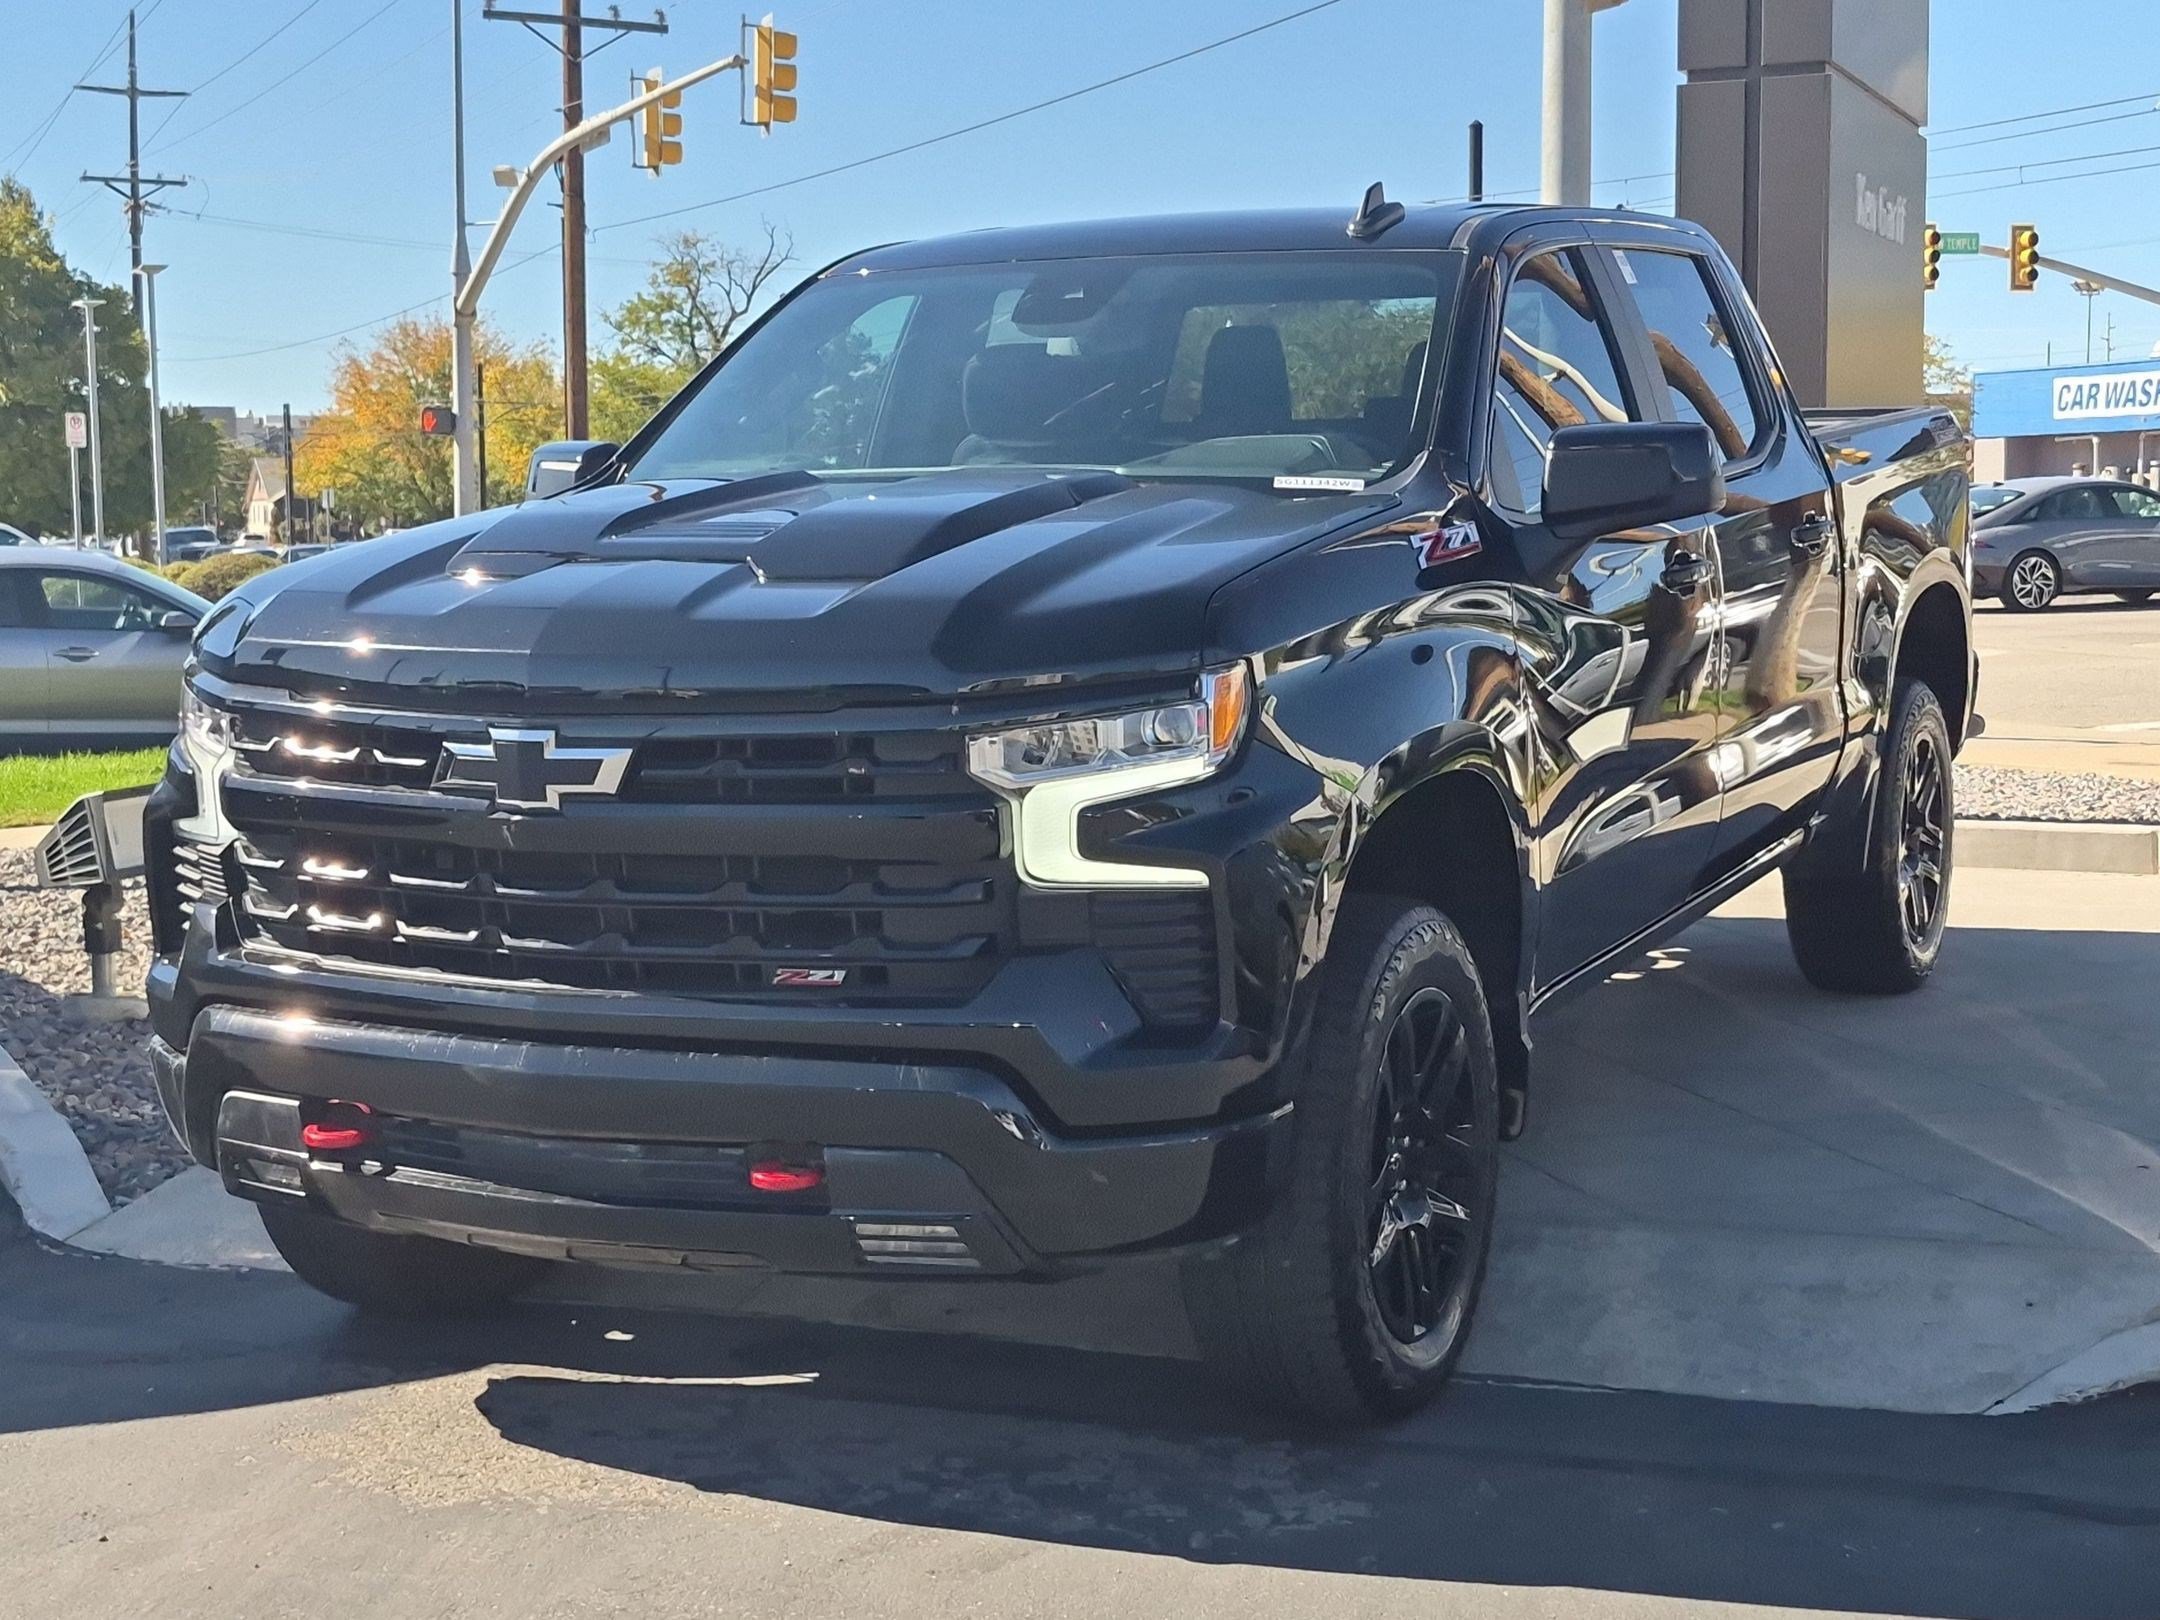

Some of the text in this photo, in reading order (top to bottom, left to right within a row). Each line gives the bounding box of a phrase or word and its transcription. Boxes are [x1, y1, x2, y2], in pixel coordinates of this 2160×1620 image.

[1947, 238, 1978, 250] TEMPLE
[2058, 383, 2100, 412] CAR
[1410, 521, 1482, 569] Z71
[772, 968, 846, 986] Z71
